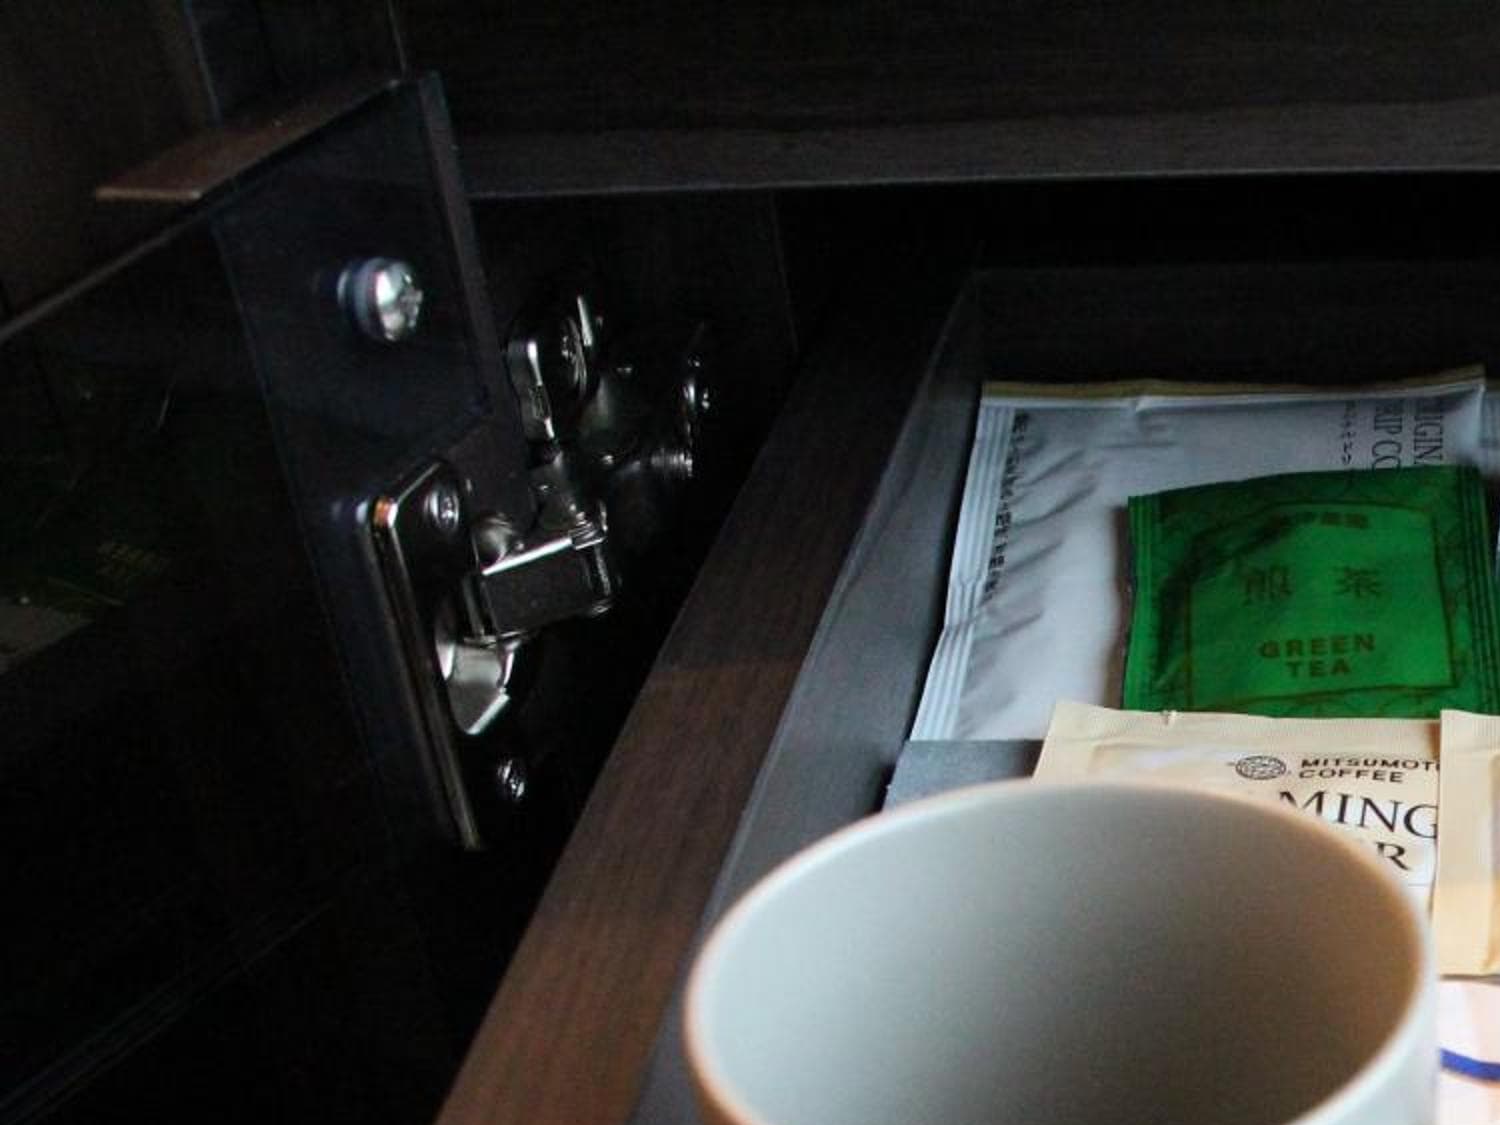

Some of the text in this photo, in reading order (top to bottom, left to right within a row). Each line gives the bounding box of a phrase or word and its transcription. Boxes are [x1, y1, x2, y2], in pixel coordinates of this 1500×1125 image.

[1259, 633, 1376, 658] GREEN
[1286, 659, 1351, 677] TEA
[1301, 757, 1440, 773] MITSUMOT
[1299, 768, 1404, 783] COFFEE
